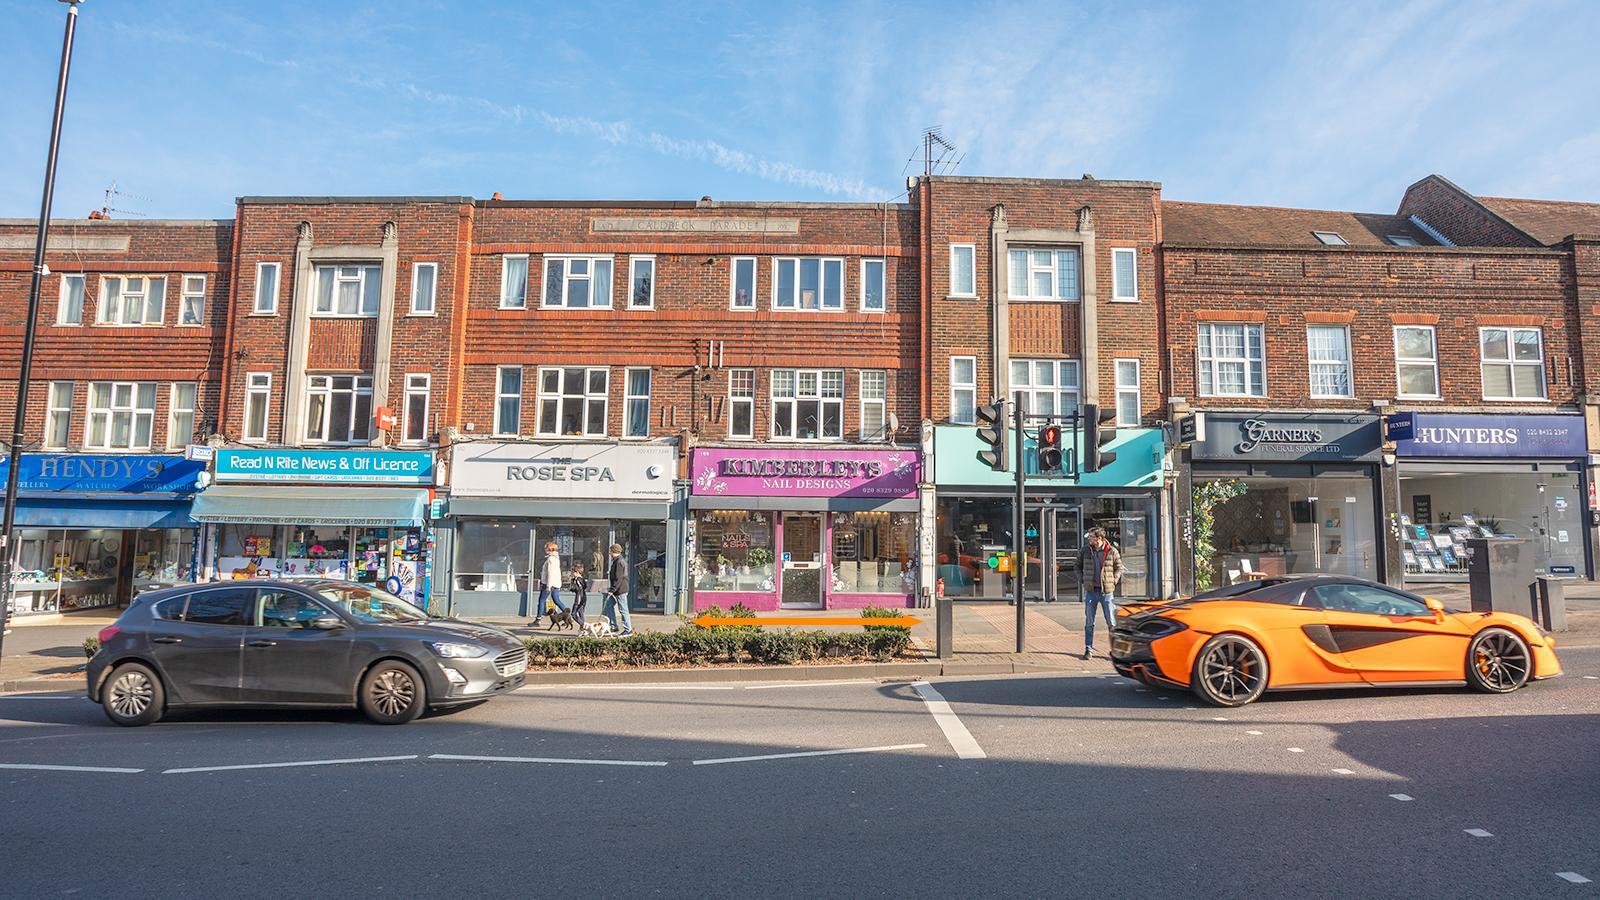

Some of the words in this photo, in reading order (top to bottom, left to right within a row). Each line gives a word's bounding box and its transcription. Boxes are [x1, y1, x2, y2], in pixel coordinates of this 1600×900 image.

[637, 221, 696, 230] CALDBECK
[709, 221, 753, 230] PARADE
[1414, 428, 1517, 444] HUNTERS
[1261, 445, 1294, 453] FUNERAL
[39, 458, 162, 478] HENDY'S
[230, 456, 262, 469] Read
[264, 456, 274, 469] N
[276, 456, 299, 469] Rite
[301, 457, 336, 470] News
[339, 458, 349, 470] &
[353, 458, 370, 470] Off
[373, 459, 419, 471] Licence
[551, 457, 572, 465] THE
[722, 459, 883, 477] KIMBERLEY'S
[507, 466, 567, 481] ROSE
[570, 466, 615, 481] SPA
[763, 479, 792, 489] NAIL
[796, 480, 851, 489] DESIGNS
